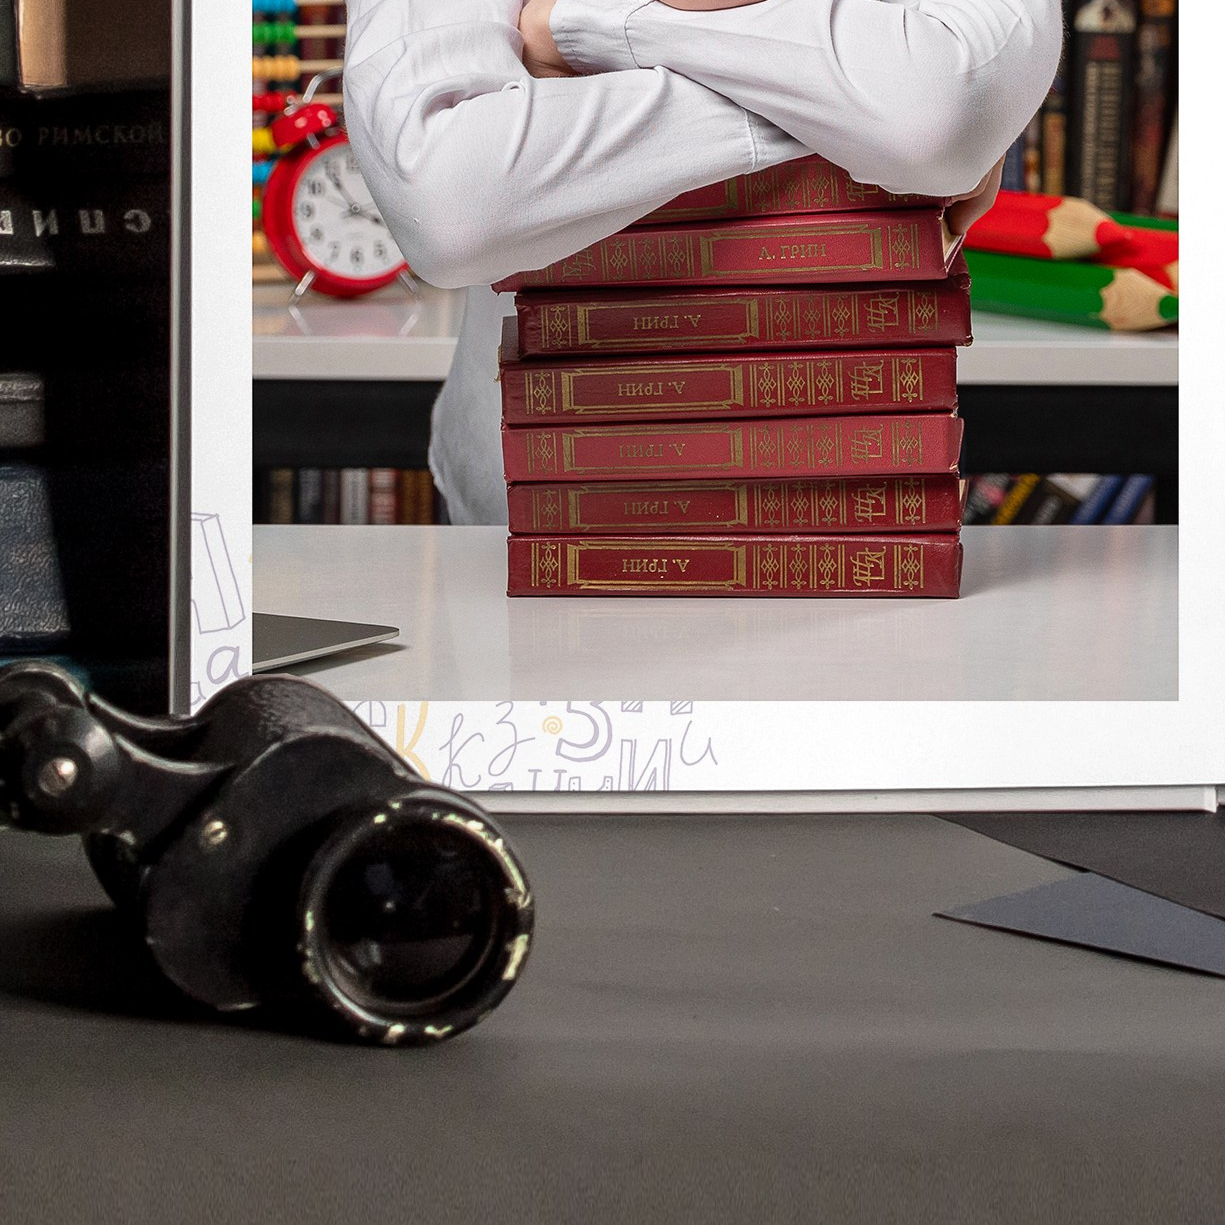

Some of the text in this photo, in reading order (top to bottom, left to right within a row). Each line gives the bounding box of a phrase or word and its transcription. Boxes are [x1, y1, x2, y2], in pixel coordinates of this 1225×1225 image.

[780, 242, 827, 259] ГРИН
[633, 315, 676, 331] ГРИН
[618, 382, 660, 397] ГРИН
[624, 501, 665, 515] ГРИН
[622, 558, 666, 574] ГРИН
